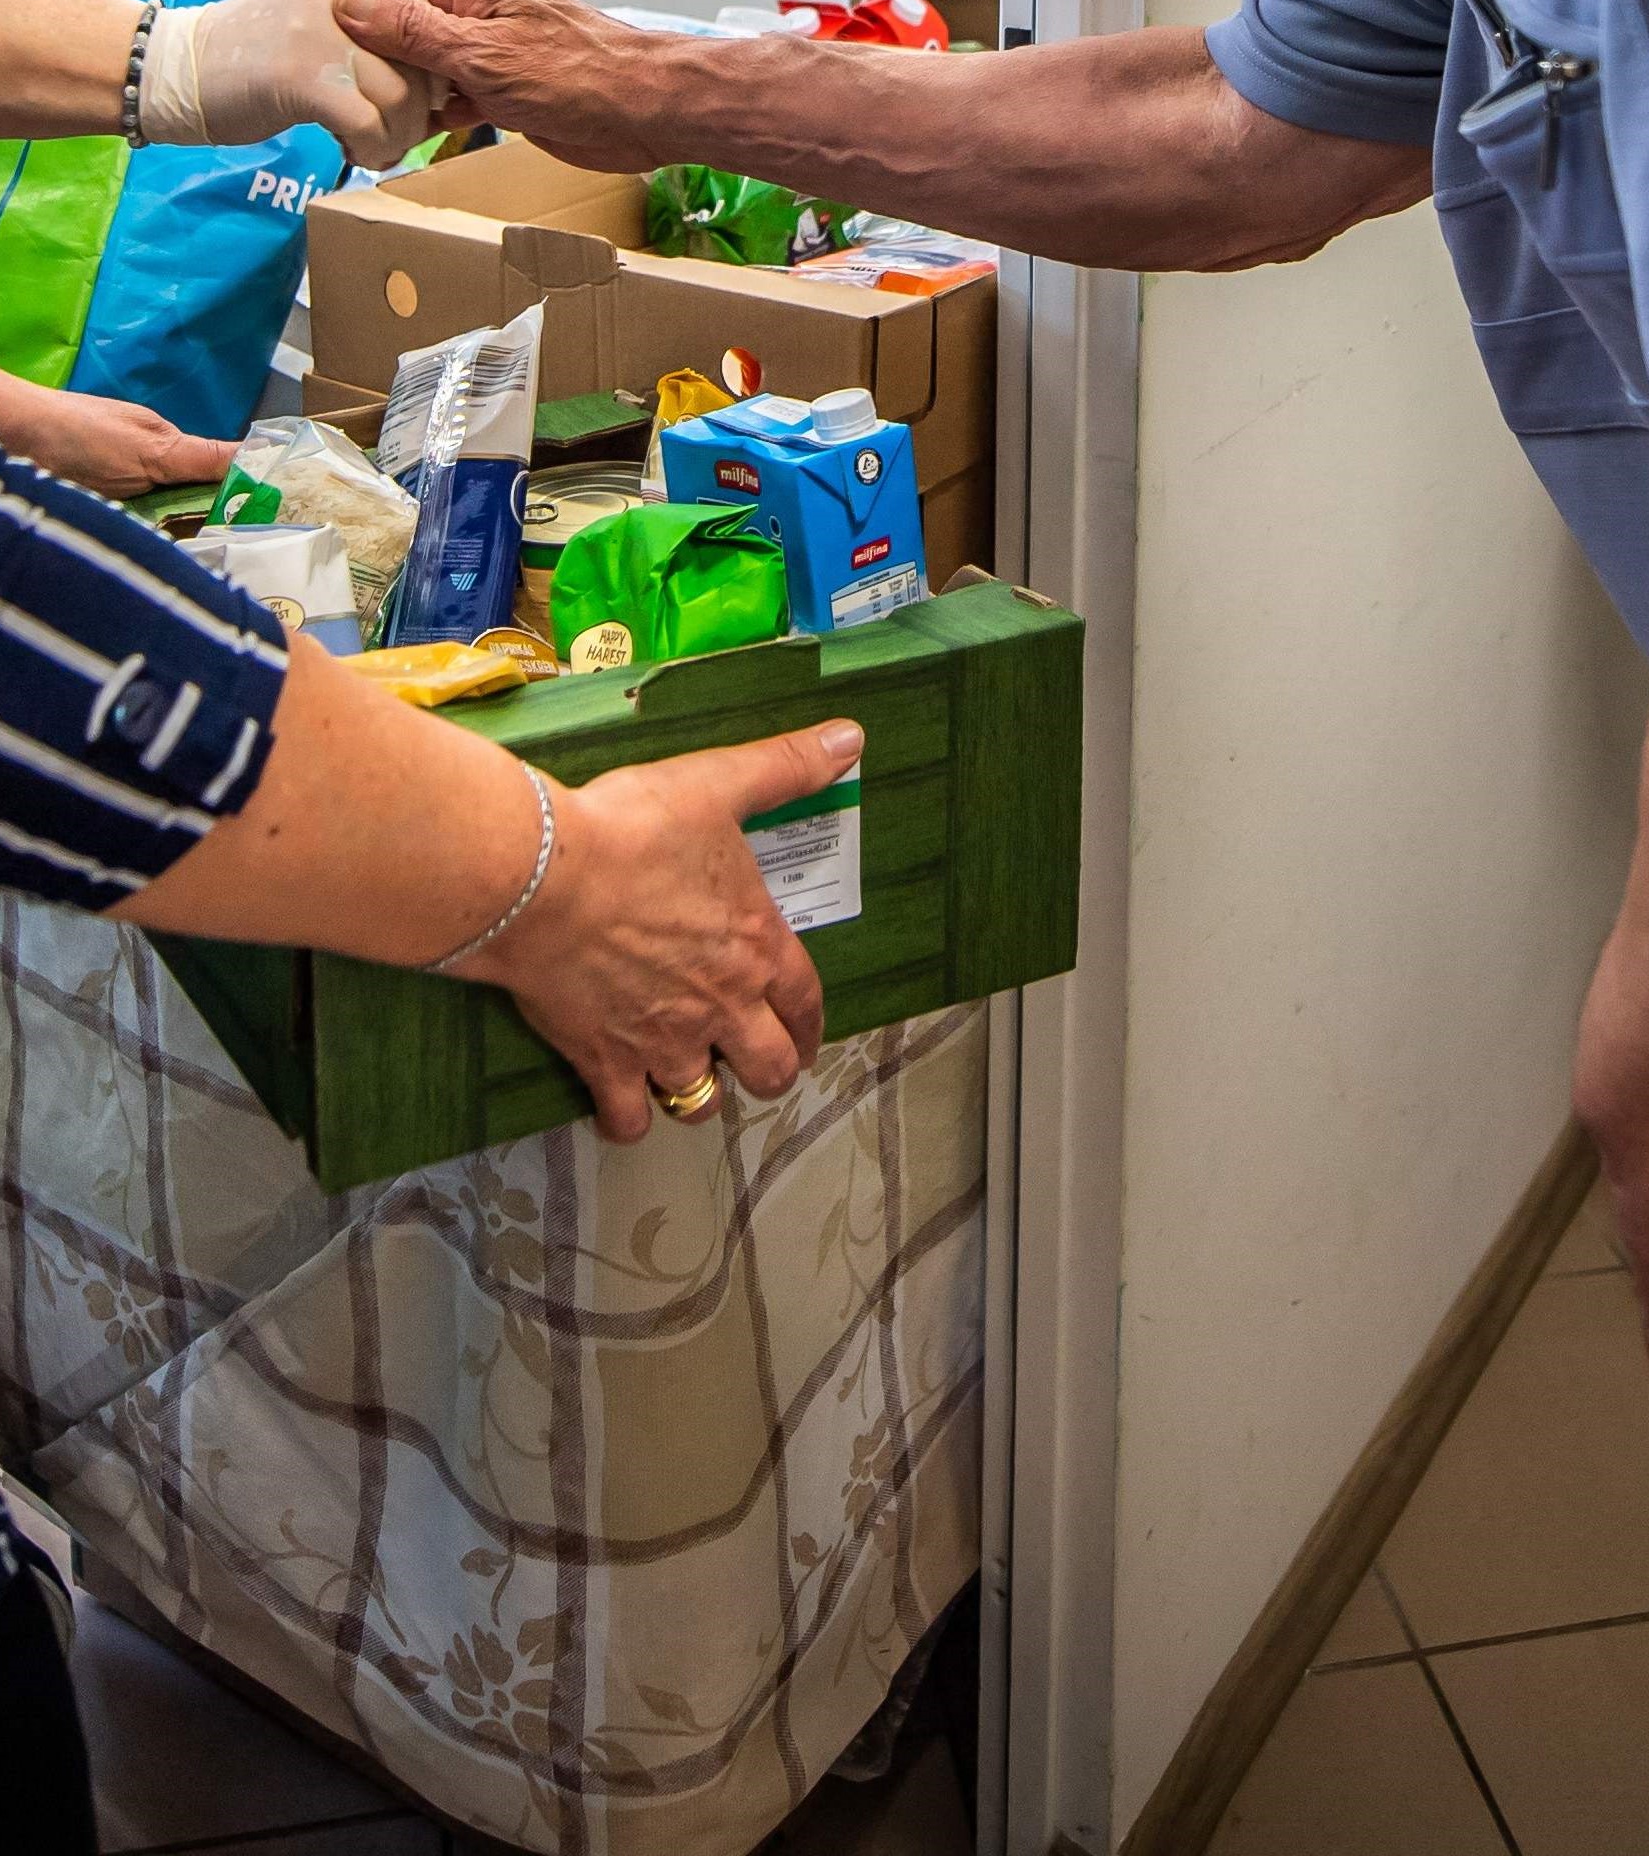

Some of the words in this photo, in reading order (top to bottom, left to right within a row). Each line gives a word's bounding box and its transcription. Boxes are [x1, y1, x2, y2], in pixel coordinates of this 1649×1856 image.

[720, 467, 759, 488] milfina
[854, 542, 889, 563] milfina
[599, 629, 627, 647] HAPPY
